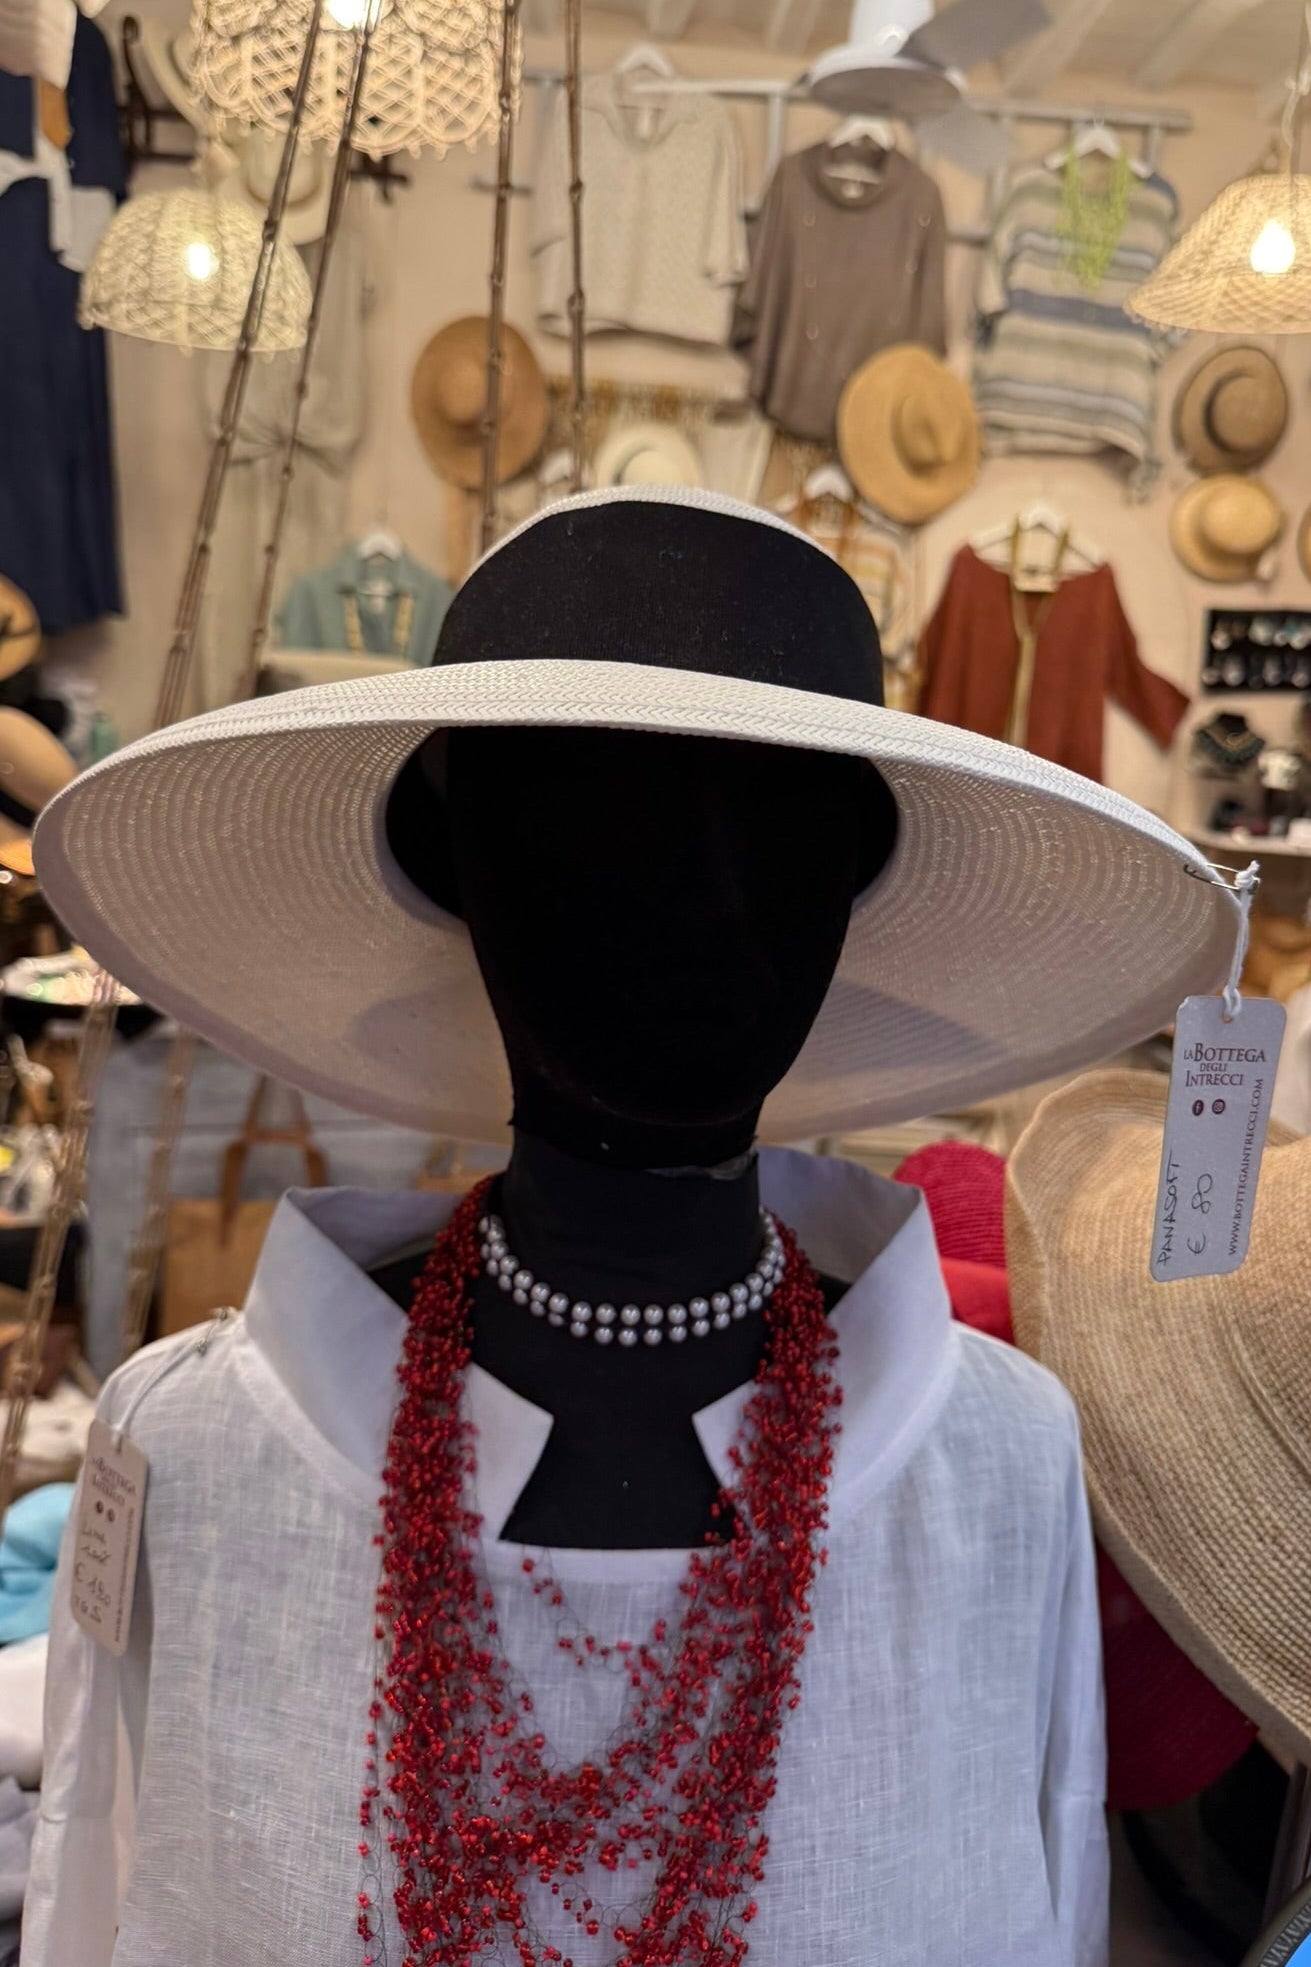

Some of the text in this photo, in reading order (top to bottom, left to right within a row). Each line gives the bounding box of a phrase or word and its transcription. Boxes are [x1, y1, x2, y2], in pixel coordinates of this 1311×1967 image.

[1183, 1043, 1267, 1063] LA BOTTEGA
[1200, 1062, 1227, 1072] DEGLI
[1185, 1070, 1244, 1088] INTRECCI
[1229, 1078, 1264, 1256] WWW.BOTTEGAINTRECCI.COM
[1187, 1173, 1214, 1256] € 80
